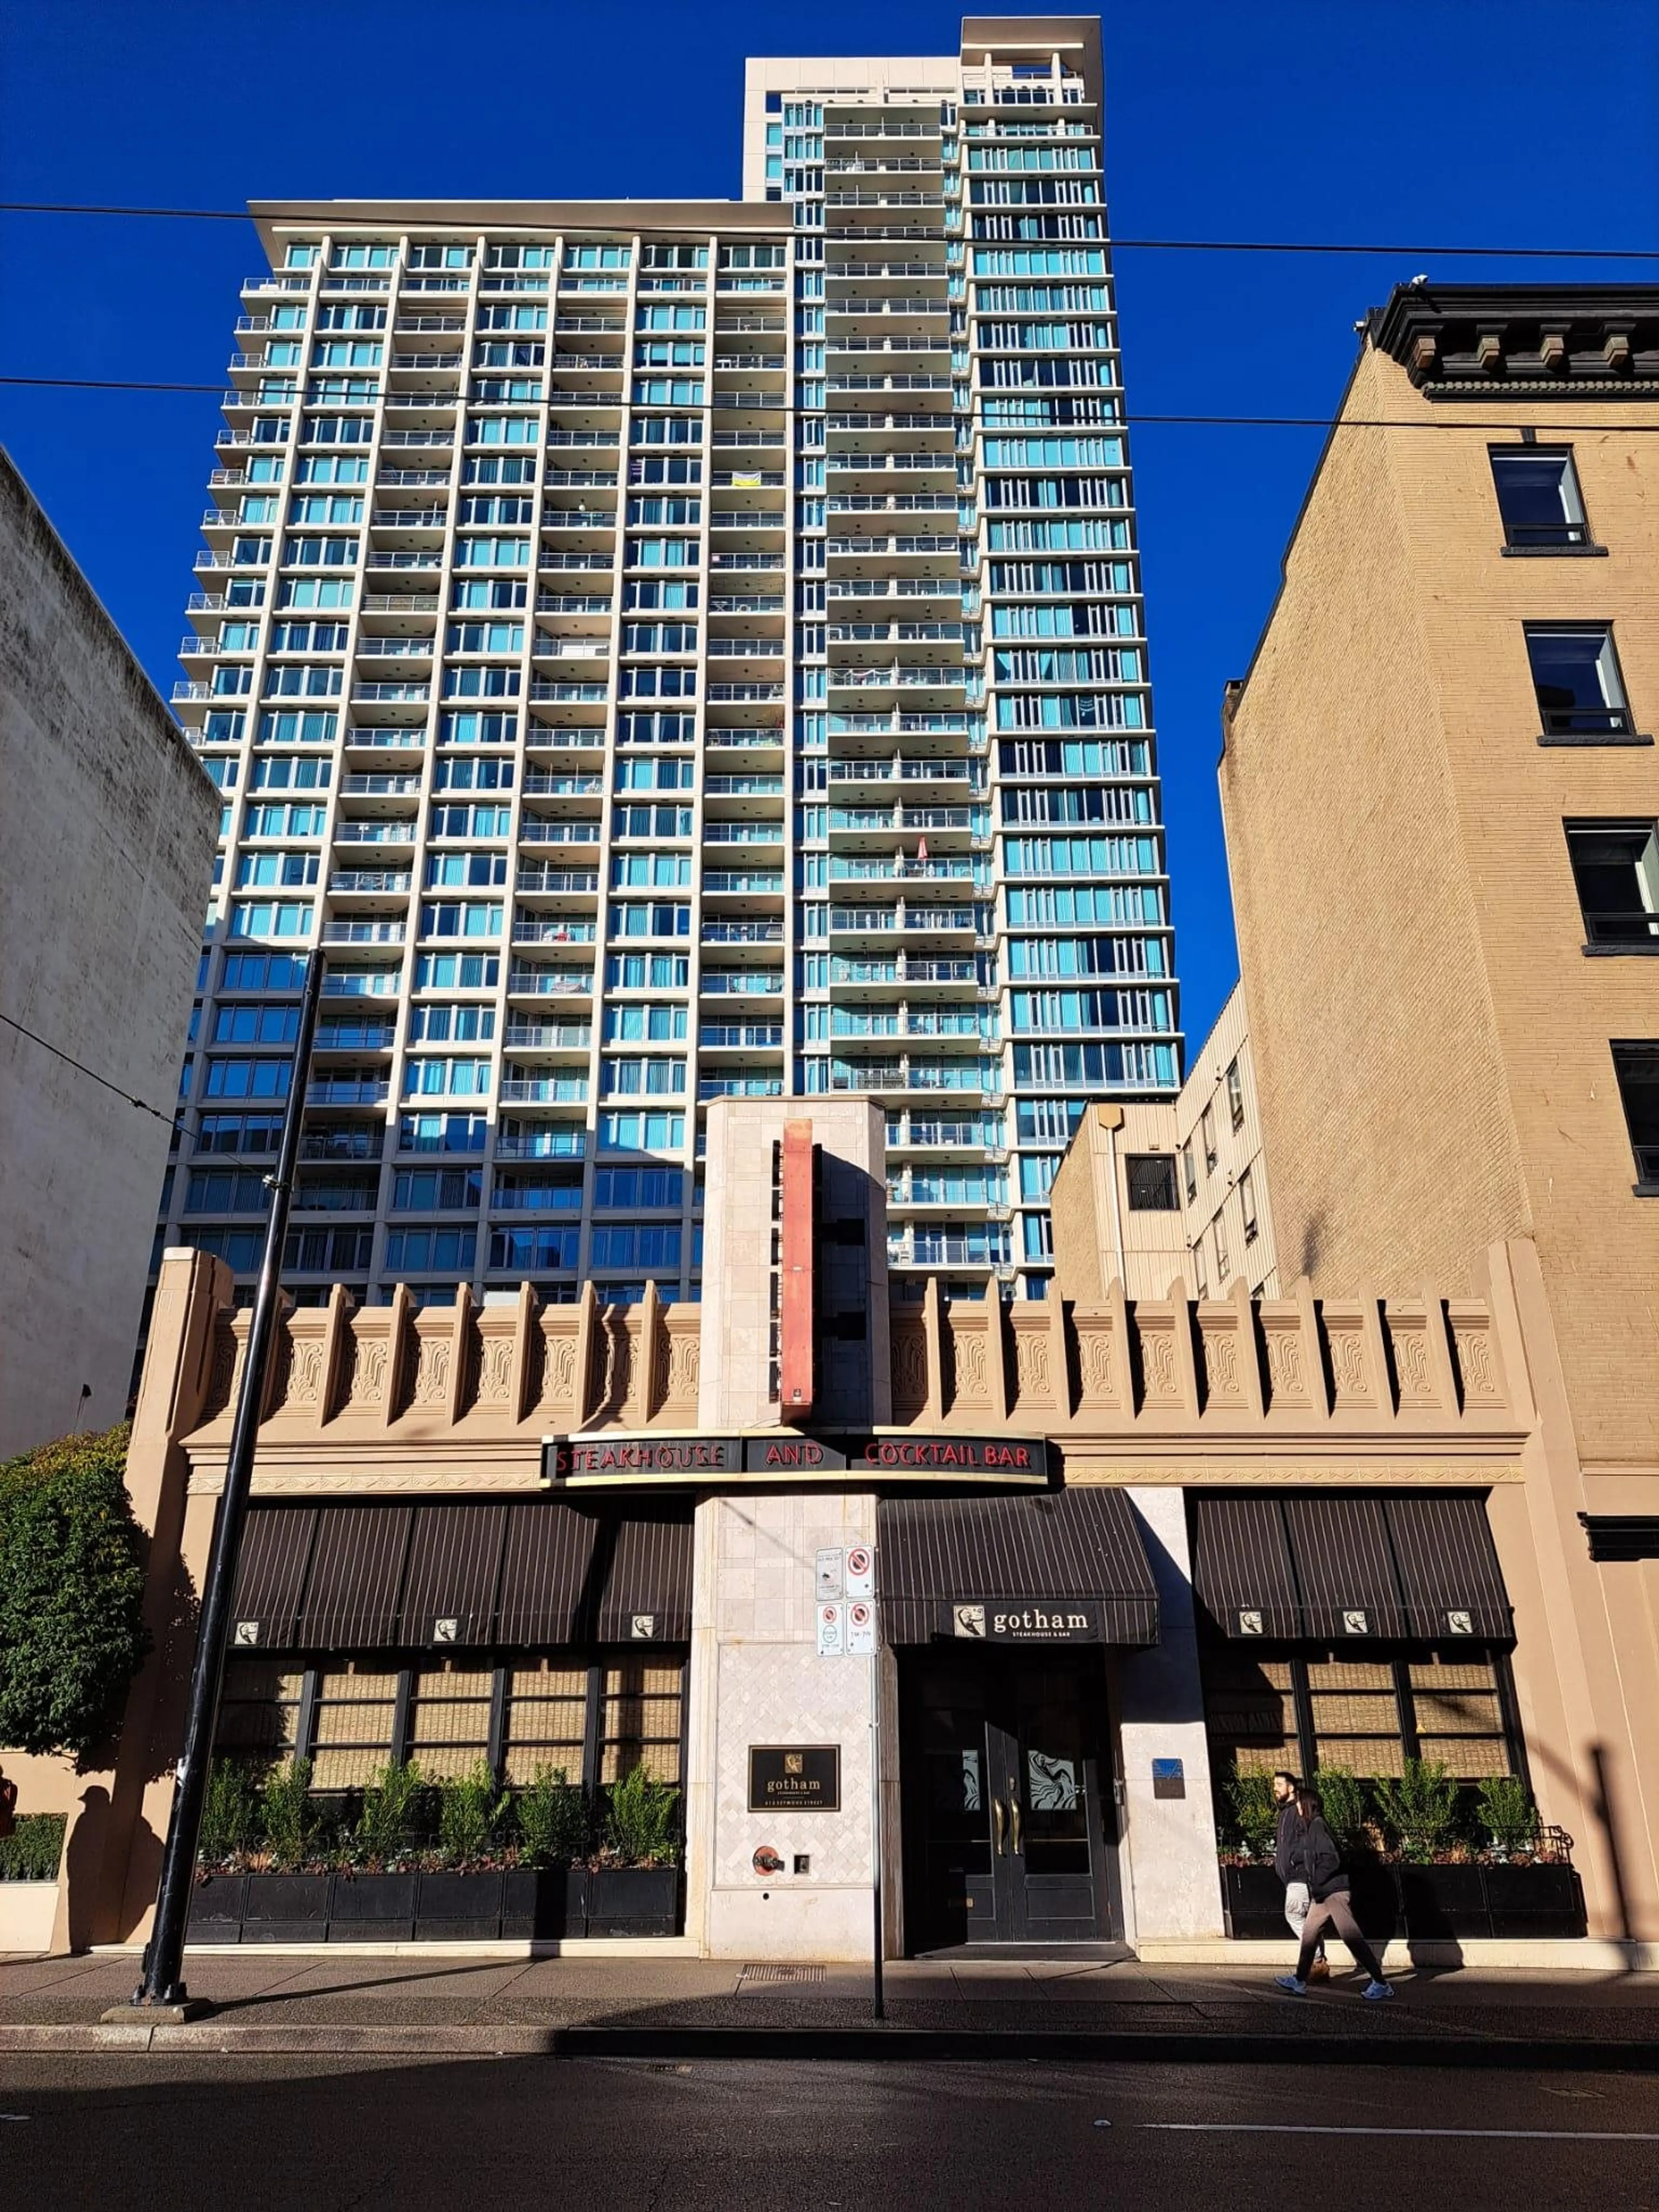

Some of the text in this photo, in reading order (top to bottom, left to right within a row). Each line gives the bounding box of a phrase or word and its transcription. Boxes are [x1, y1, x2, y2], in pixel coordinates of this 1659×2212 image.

[556, 1443, 1030, 1470] STEAKHOUSE AND COCKTAIL BAR
[994, 1609, 1088, 1633] gotham
[767, 1777, 820, 1792] gotham
